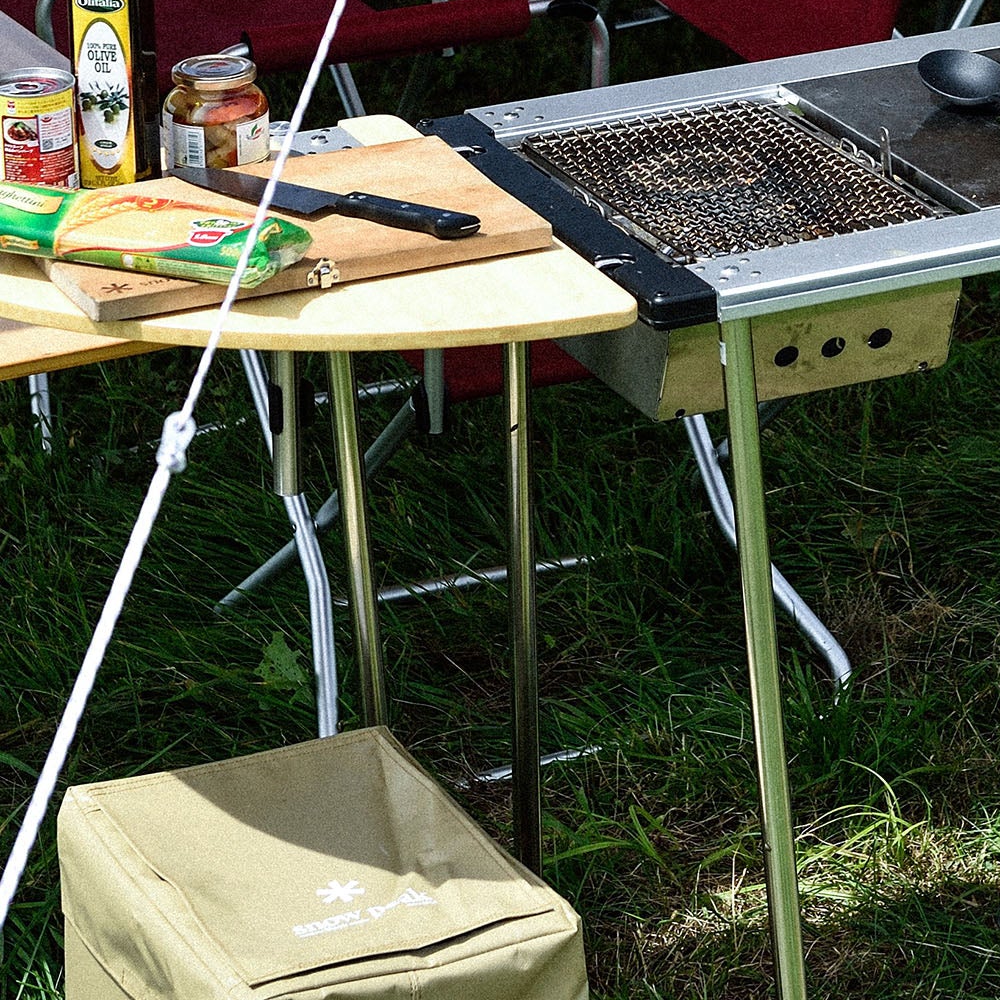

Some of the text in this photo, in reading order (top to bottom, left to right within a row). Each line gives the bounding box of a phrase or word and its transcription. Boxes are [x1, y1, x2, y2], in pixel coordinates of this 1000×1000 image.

[86, 42, 117, 51] 100% PURE
[87, 50, 117, 62] OLIVE
[94, 62, 111, 73] OIL
[291, 909, 362, 936] snow
